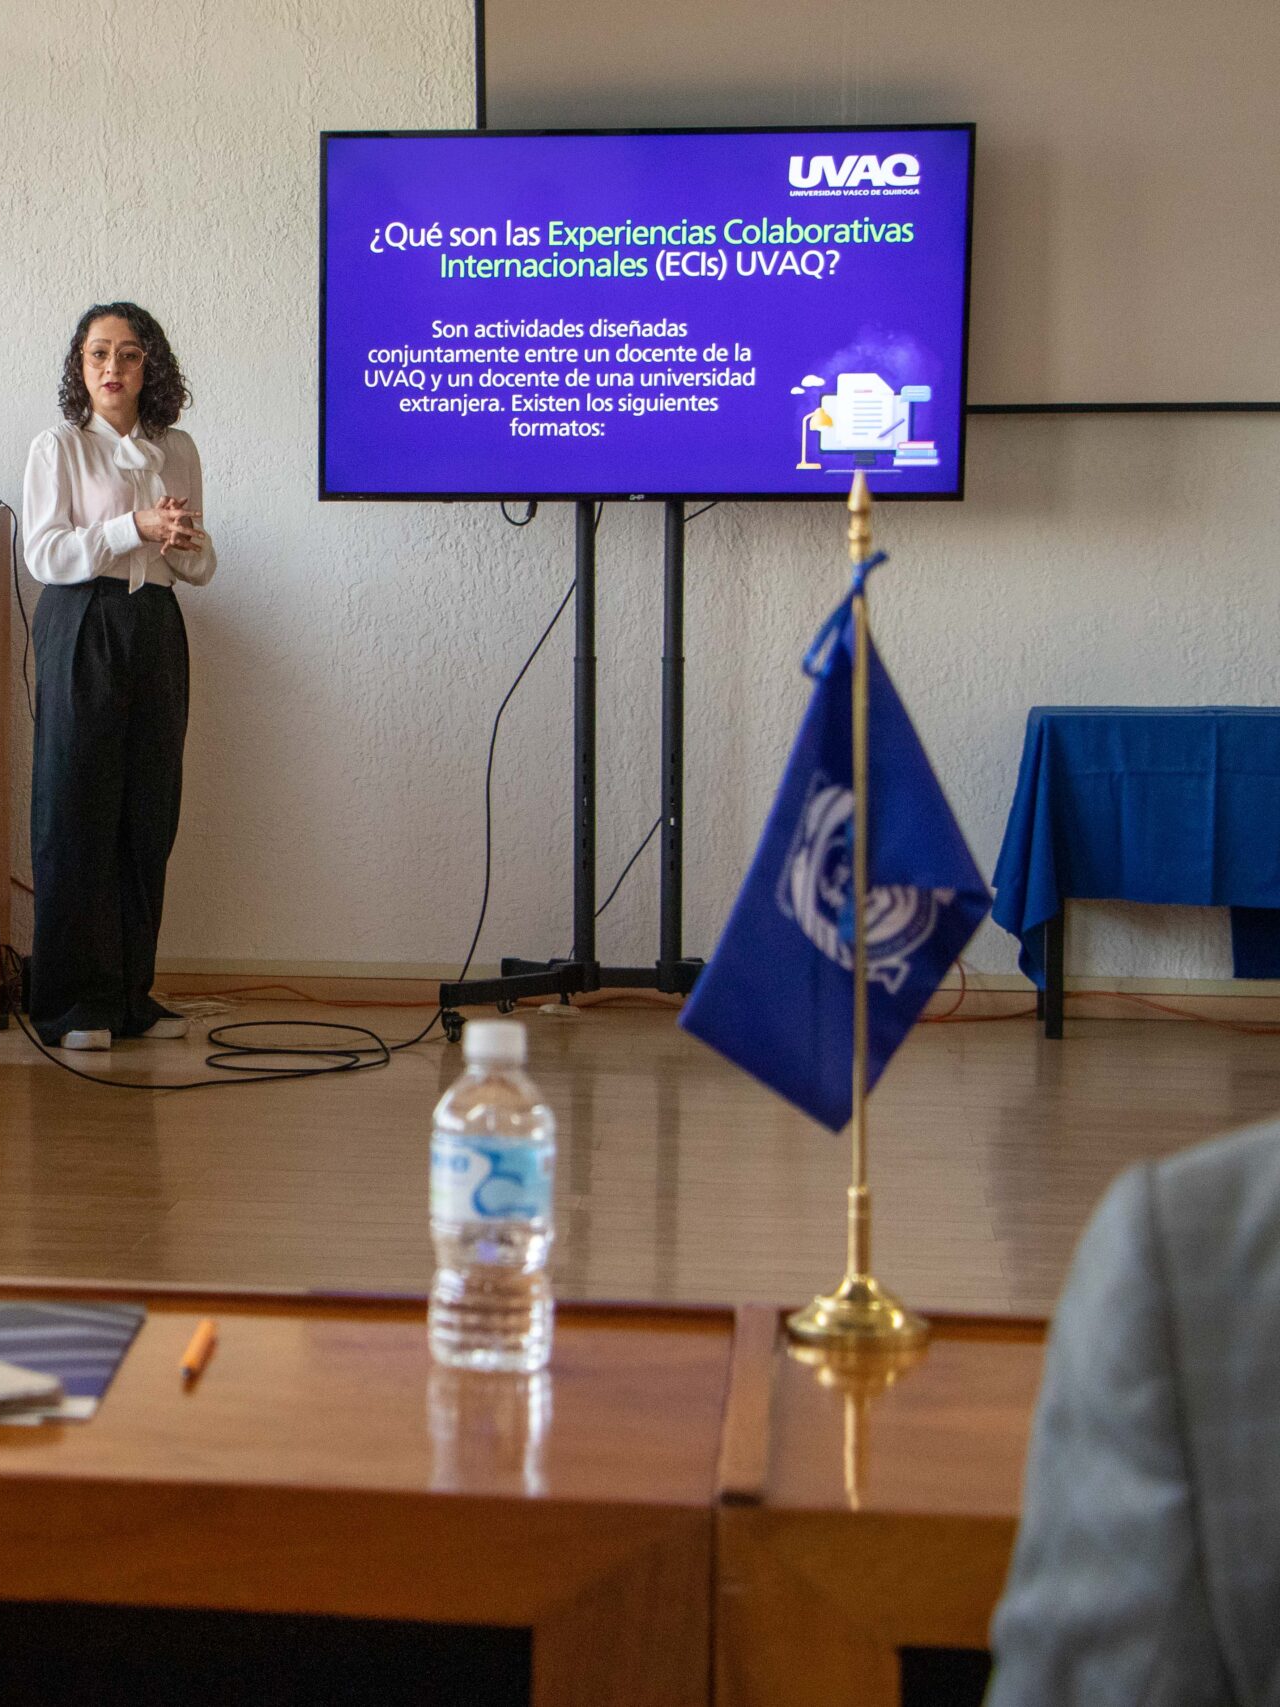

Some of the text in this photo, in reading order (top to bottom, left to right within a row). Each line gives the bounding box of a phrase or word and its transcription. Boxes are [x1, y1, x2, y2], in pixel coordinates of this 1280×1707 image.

[788, 152, 921, 189] UVAQ
[789, 189, 842, 197] UNIVERSIDAD
[843, 188, 870, 196] VASCO
[882, 188, 920, 196] QUIROGA
[369, 216, 915, 254] ¿Qué son las Experiencias Colaborativas
[440, 252, 649, 279] Internacionales
[736, 250, 841, 281] UVAQ?
[431, 318, 689, 339] Son actividades diseñadas
[367, 342, 752, 369] conjuntamente entre un docente de la
[364, 366, 756, 393] UVAQ y un docente de una universidad
[399, 392, 720, 417] extranjera. Existen los siguientes
[509, 416, 606, 437] formatos:
